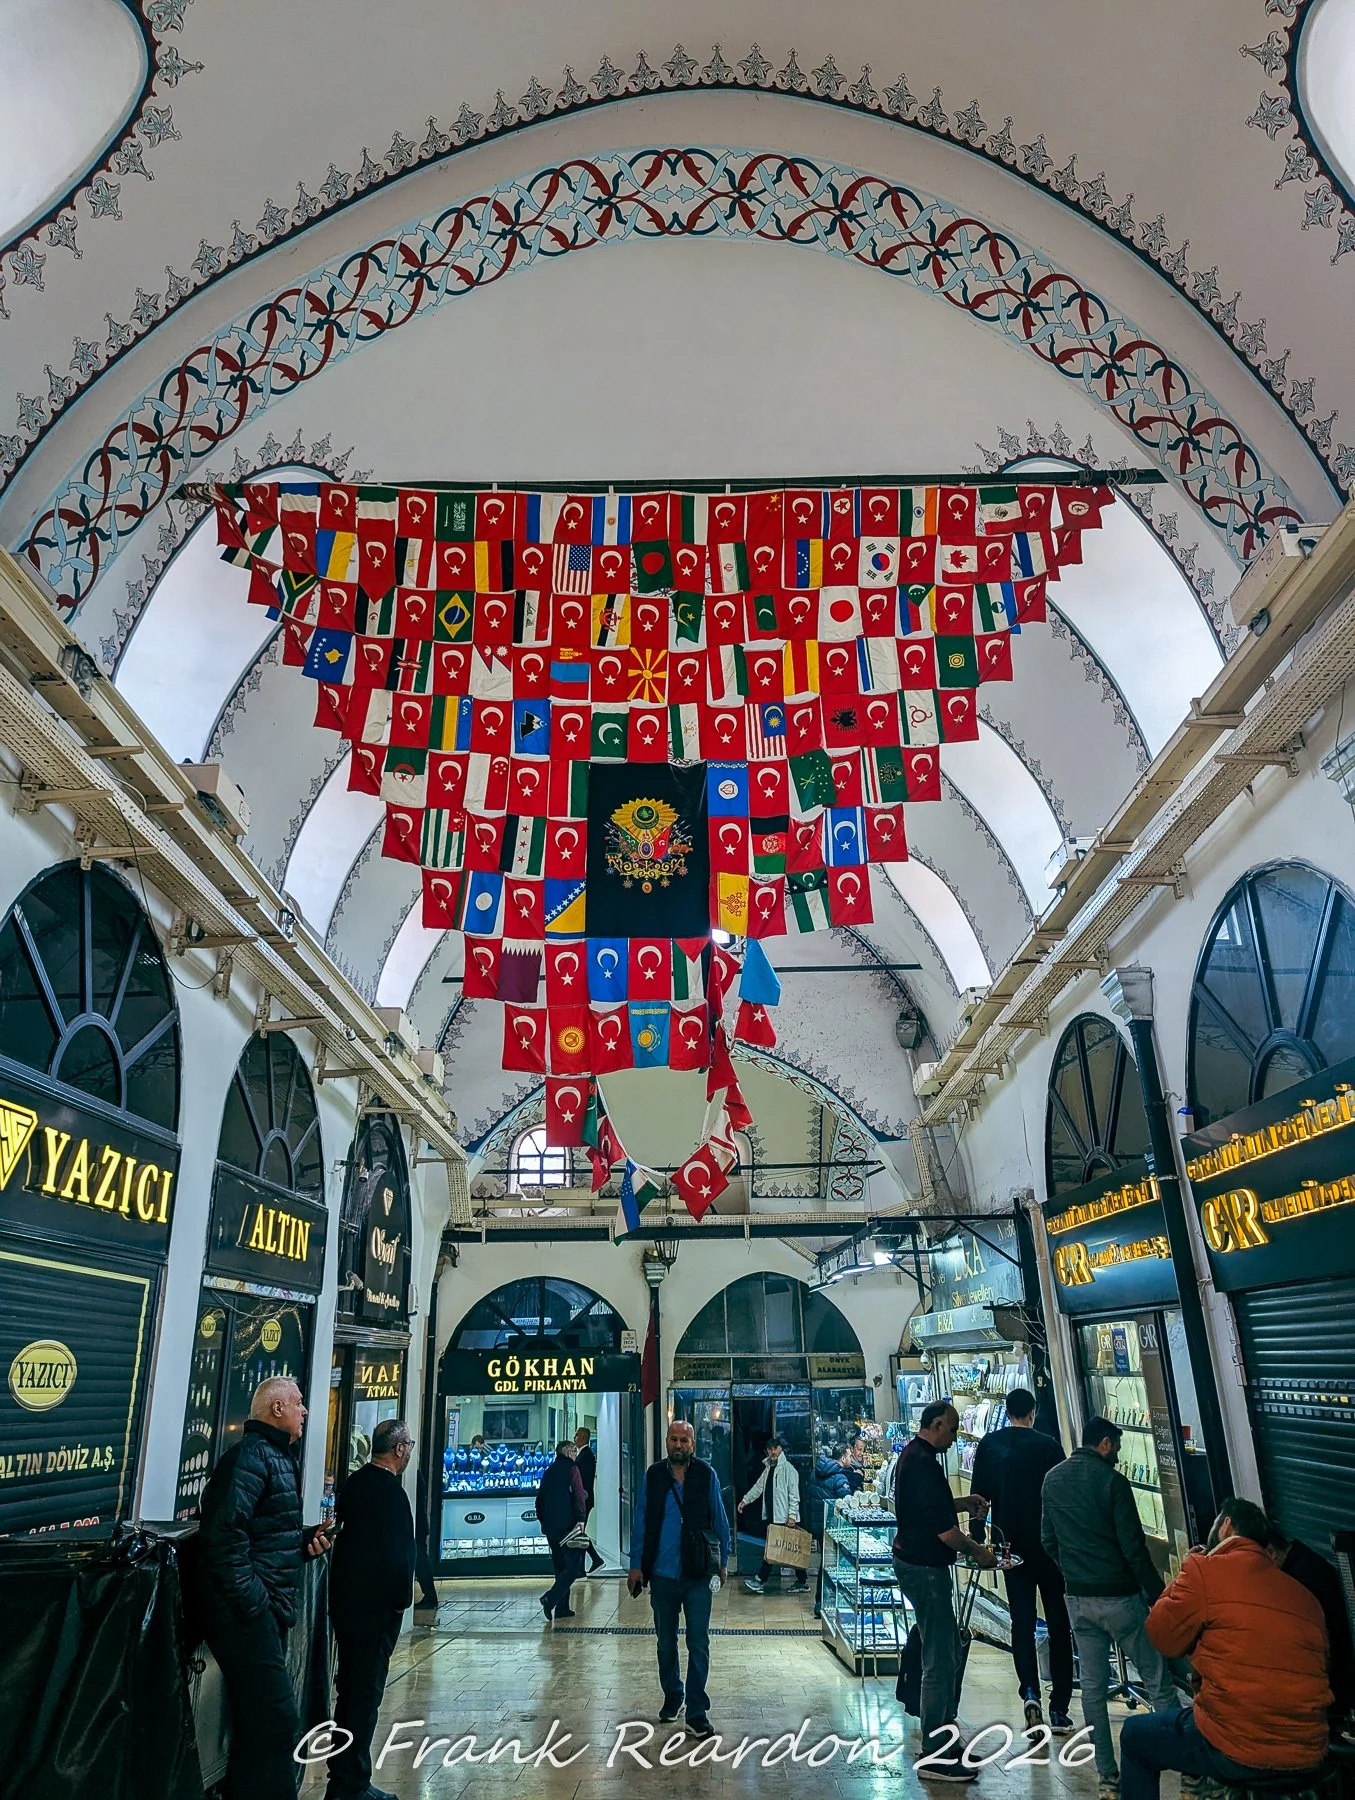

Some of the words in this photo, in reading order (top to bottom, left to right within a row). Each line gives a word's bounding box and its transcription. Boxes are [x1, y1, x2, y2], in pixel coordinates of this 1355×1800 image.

[42, 1127, 174, 1224] YAZICI
[249, 1203, 311, 1262] ALTIN
[937, 1312, 954, 1333] E&A
[17, 1361, 70, 1389] YAZICI
[487, 1355, 595, 1377] GÖKHAN
[494, 1380, 519, 1392] GDL
[524, 1379, 587, 1391] PIRLANTA
[627, 1383, 637, 1393] 23
[46, 1444, 88, 1472] DÖVİZ
[91, 1446, 115, 1471] A.Ş.
